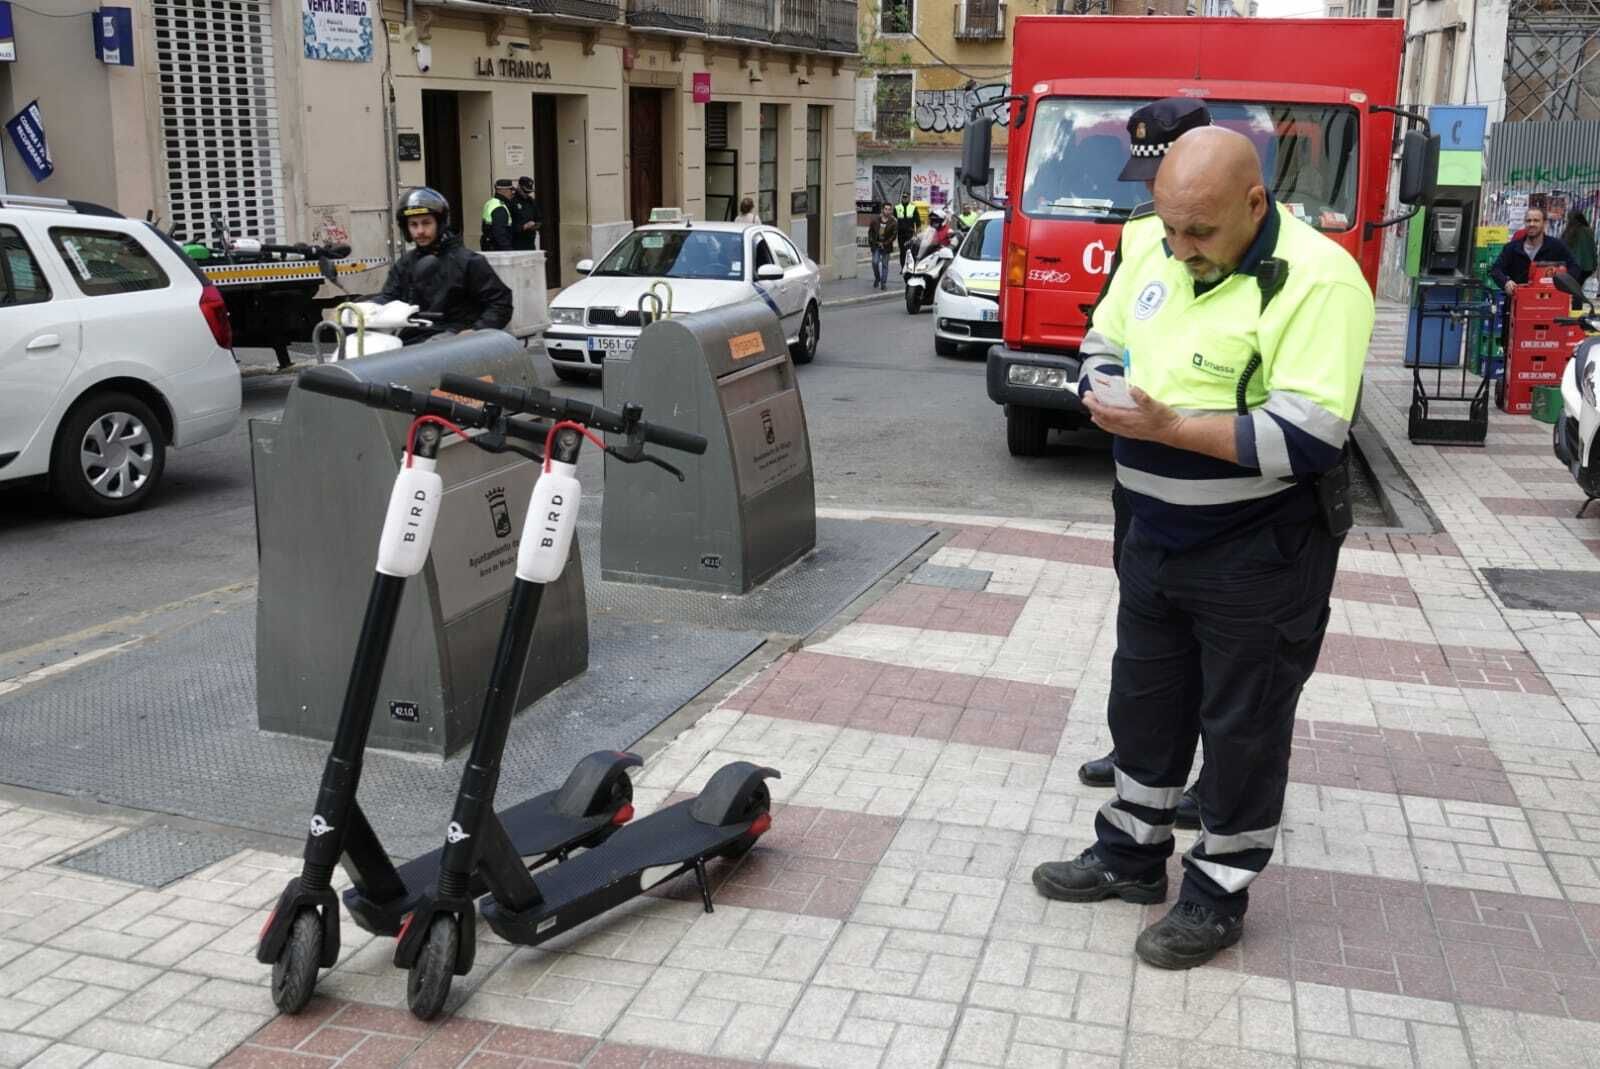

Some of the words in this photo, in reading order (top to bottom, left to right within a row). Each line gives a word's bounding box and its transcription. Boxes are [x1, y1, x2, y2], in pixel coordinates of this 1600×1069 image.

[307, 0, 333, 12] VENTA
[334, 0, 344, 14] DE
[346, 0, 367, 16] HIELO
[477, 57, 495, 77] LA
[499, 58, 552, 79] TRANCA
[1452, 119, 1463, 145] C
[1082, 239, 1116, 275] Cr
[598, 338, 620, 350] 1561
[403, 490, 427, 543] BIRD
[540, 494, 564, 548] BIRD
